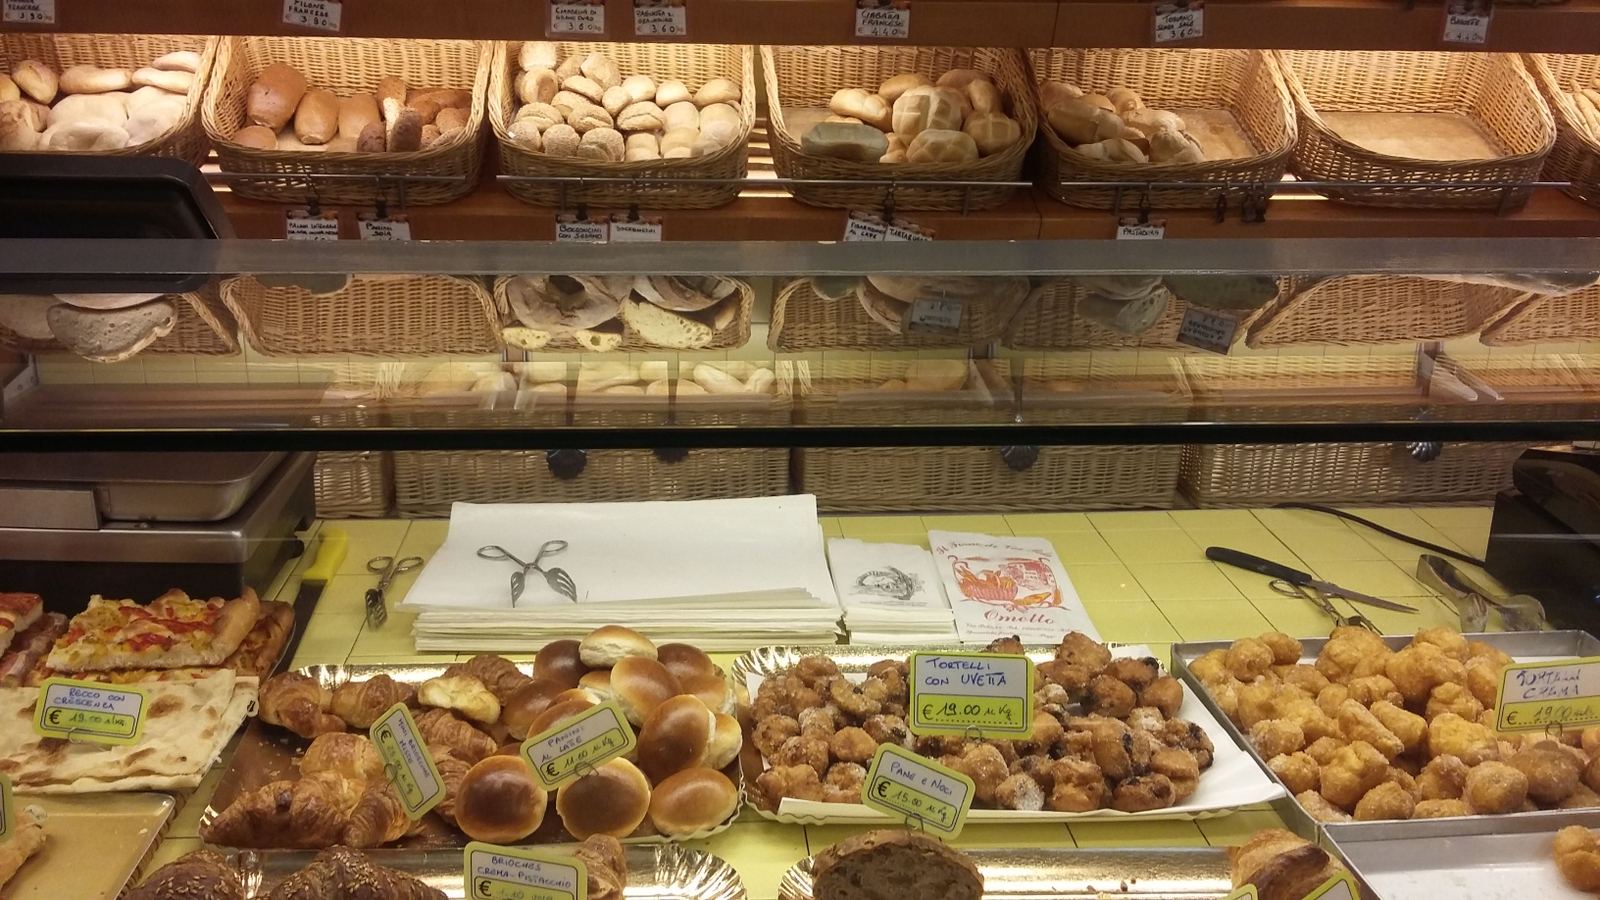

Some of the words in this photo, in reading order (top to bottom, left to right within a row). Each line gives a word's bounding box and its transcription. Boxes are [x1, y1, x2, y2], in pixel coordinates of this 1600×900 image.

[926, 657, 990, 670] TORTELLI
[925, 676, 949, 686] CON
[961, 671, 1007, 687] UVETTA
[49, 710, 62, 725] €
[922, 704, 934, 721] €
[546, 762, 560, 777] €
[890, 761, 916, 781] PANE
[877, 780, 892, 798] €
